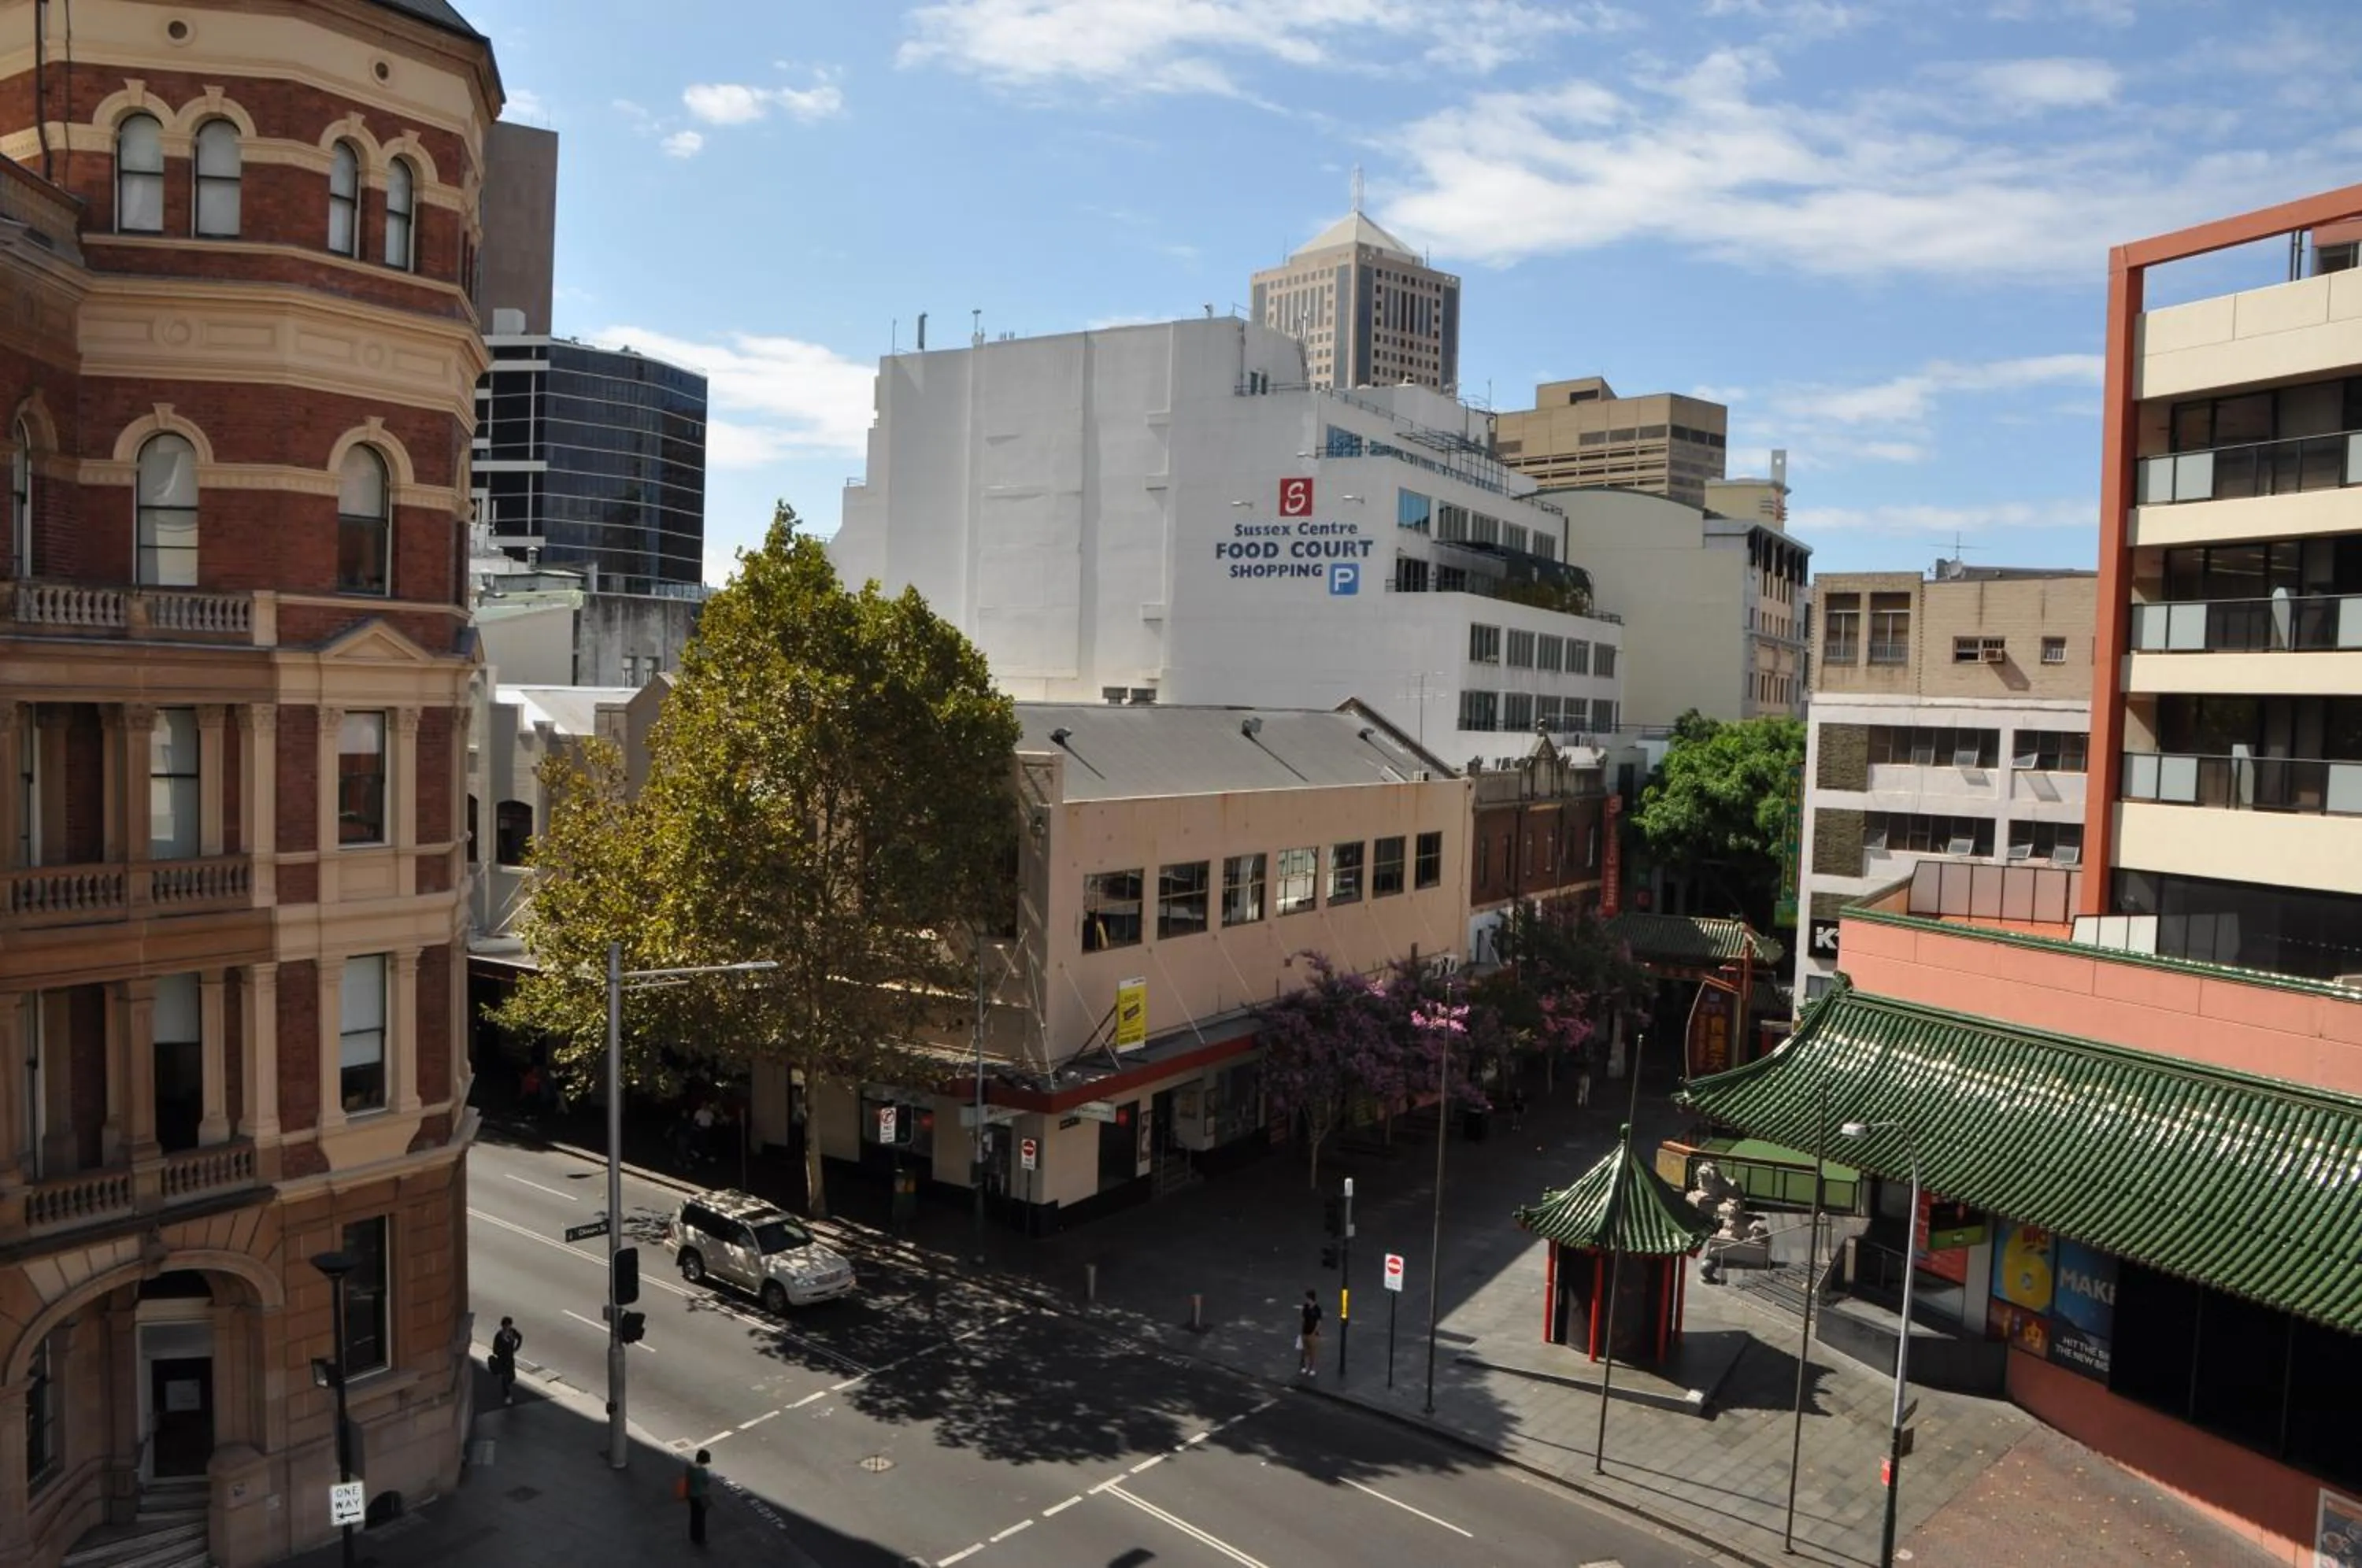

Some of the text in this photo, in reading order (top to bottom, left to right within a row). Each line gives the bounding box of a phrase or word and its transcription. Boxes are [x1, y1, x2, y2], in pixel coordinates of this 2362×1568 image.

[1234, 521, 1358, 537] Sussex Centre
[1216, 539, 1374, 559] FOOD COURT
[1229, 564, 1324, 578] SHOPPING
[1334, 568, 1354, 592] P
[336, 1485, 360, 1497] ONE
[335, 1498, 360, 1510] WAY
